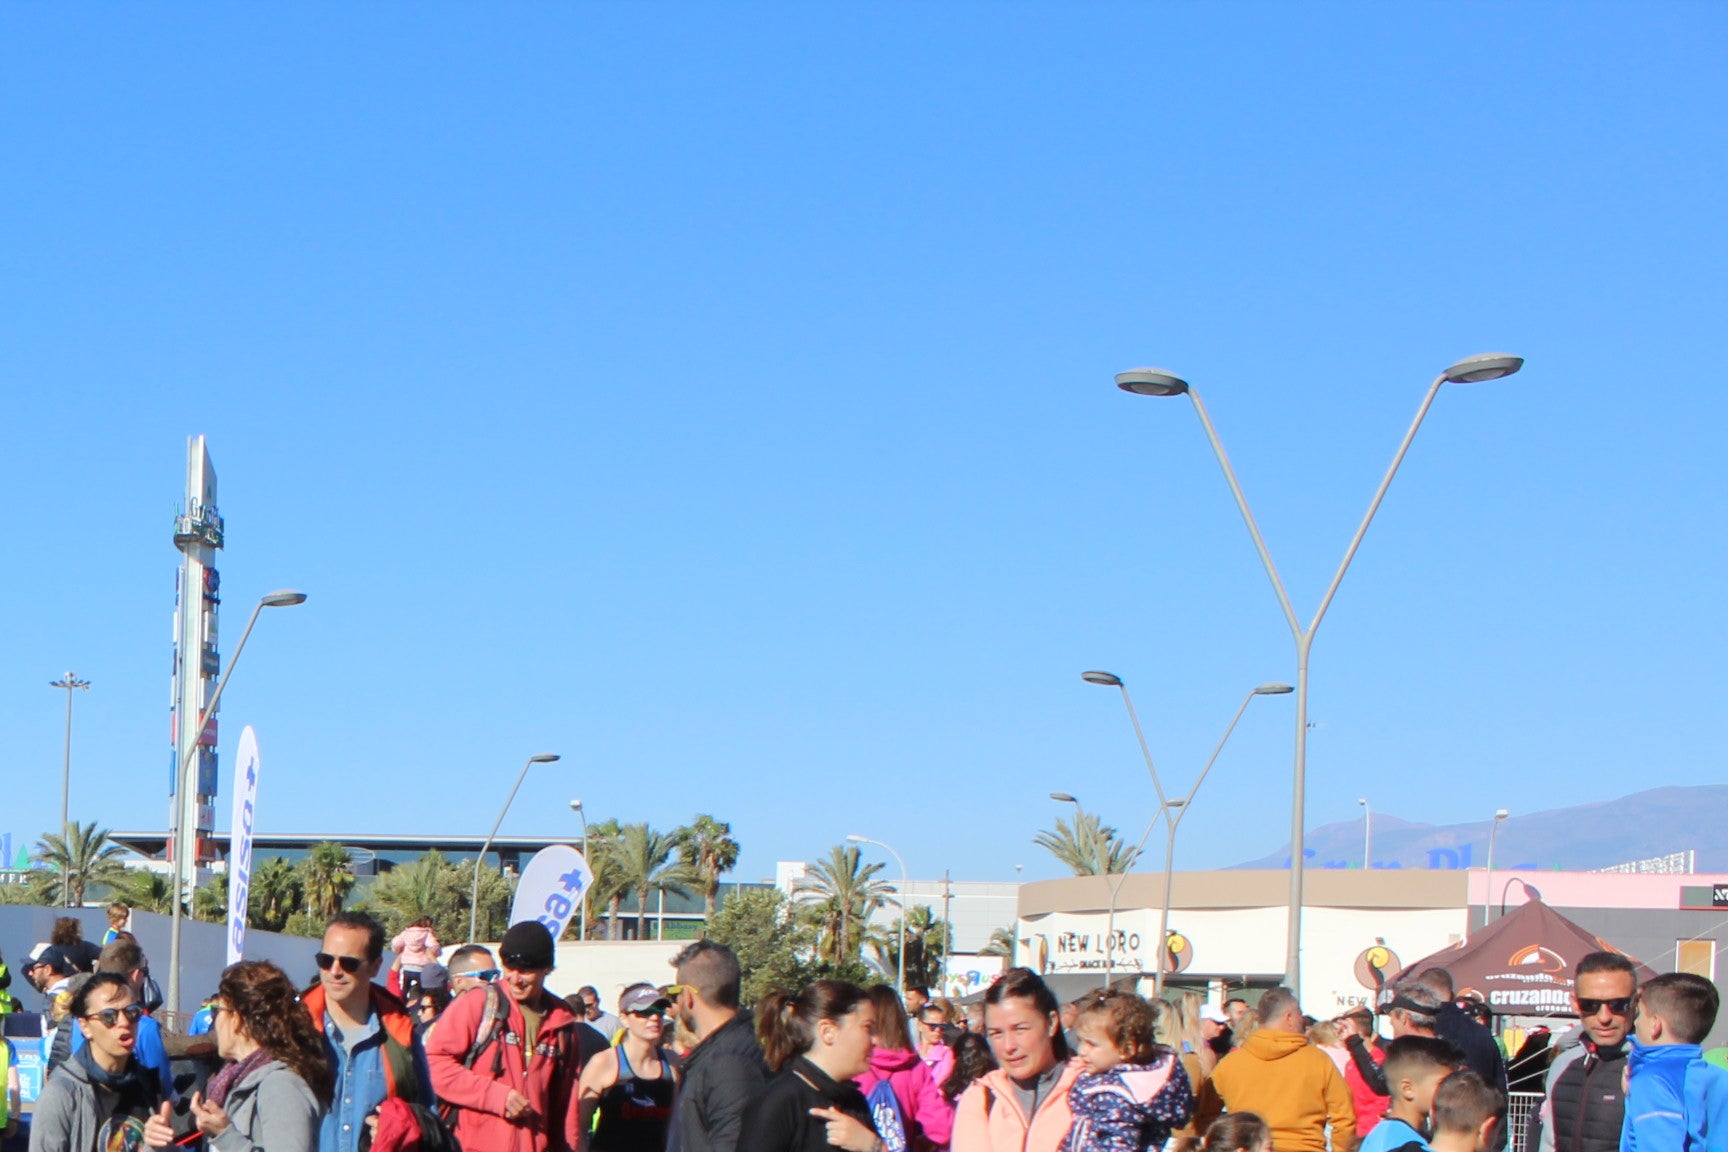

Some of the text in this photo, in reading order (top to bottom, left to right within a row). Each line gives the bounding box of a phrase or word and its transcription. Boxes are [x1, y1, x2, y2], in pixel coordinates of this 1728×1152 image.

[1057, 932, 1141, 955] NEW LORO
[1336, 995, 1369, 1007] NEW
